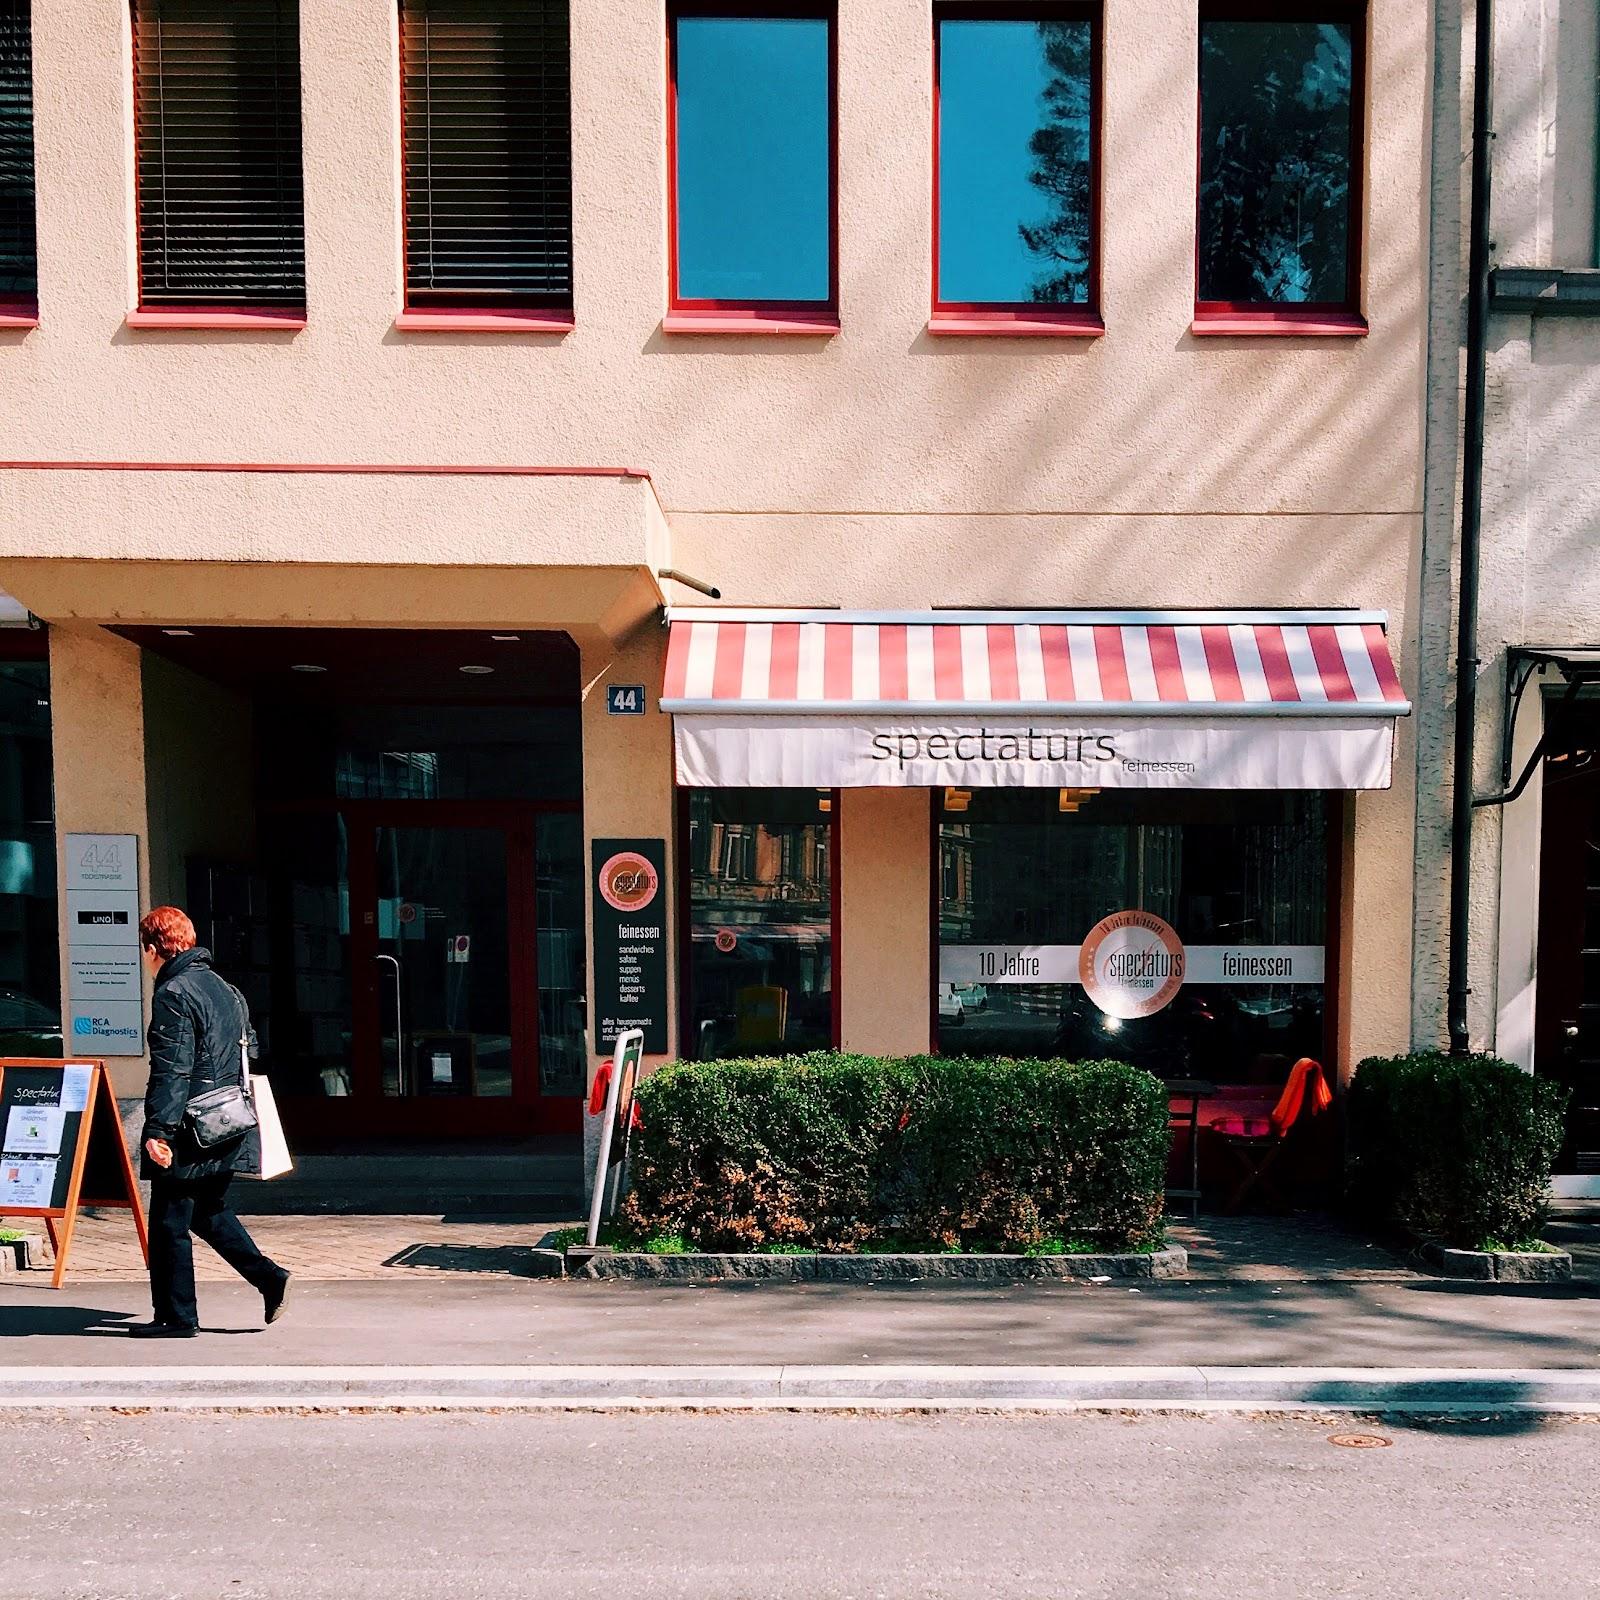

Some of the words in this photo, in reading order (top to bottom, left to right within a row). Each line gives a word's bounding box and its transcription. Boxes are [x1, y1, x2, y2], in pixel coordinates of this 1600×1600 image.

[614, 690, 636, 710] 44
[871, 727, 1117, 770] spectaturs
[1121, 759, 1195, 773] feinessen
[80, 843, 122, 873] 44
[618, 923, 660, 939] feinessen
[618, 945, 655, 954] sandwiches
[619, 966, 641, 975] suppen
[978, 952, 995, 976] 10
[999, 952, 1039, 976] Jahre
[1110, 949, 1182, 981] spectaturs
[1222, 951, 1293, 977] feinessen
[619, 984, 646, 993] desserts
[92, 1017, 110, 1026] RCA
[92, 1027, 138, 1037] Diagnostics
[602, 1026, 613, 1034] und
